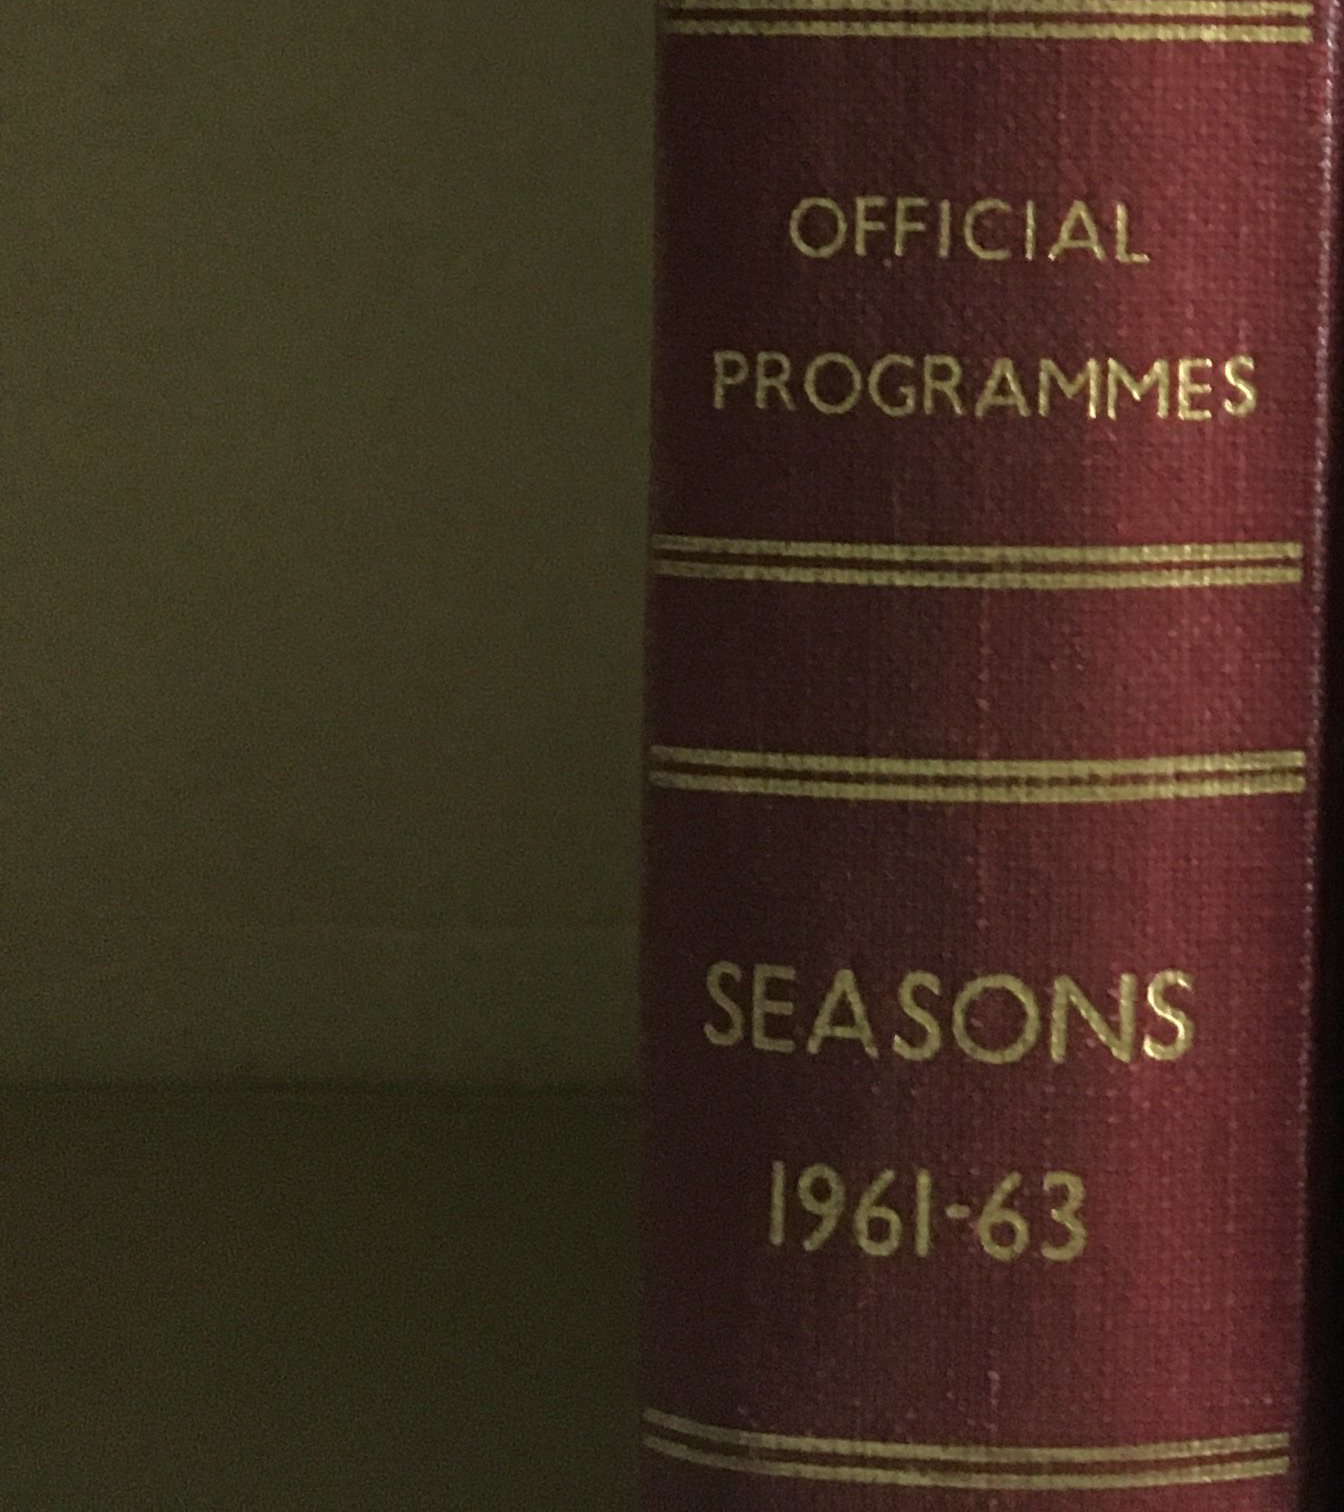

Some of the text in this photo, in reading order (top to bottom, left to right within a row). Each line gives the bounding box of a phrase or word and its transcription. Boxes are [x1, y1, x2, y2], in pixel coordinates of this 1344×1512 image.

[789, 195, 1149, 265] OFFICIAL
[714, 352, 1258, 422] PROGRAMMES
[704, 965, 1195, 1064] SEASONS
[771, 1164, 1088, 1262] 1961-63
